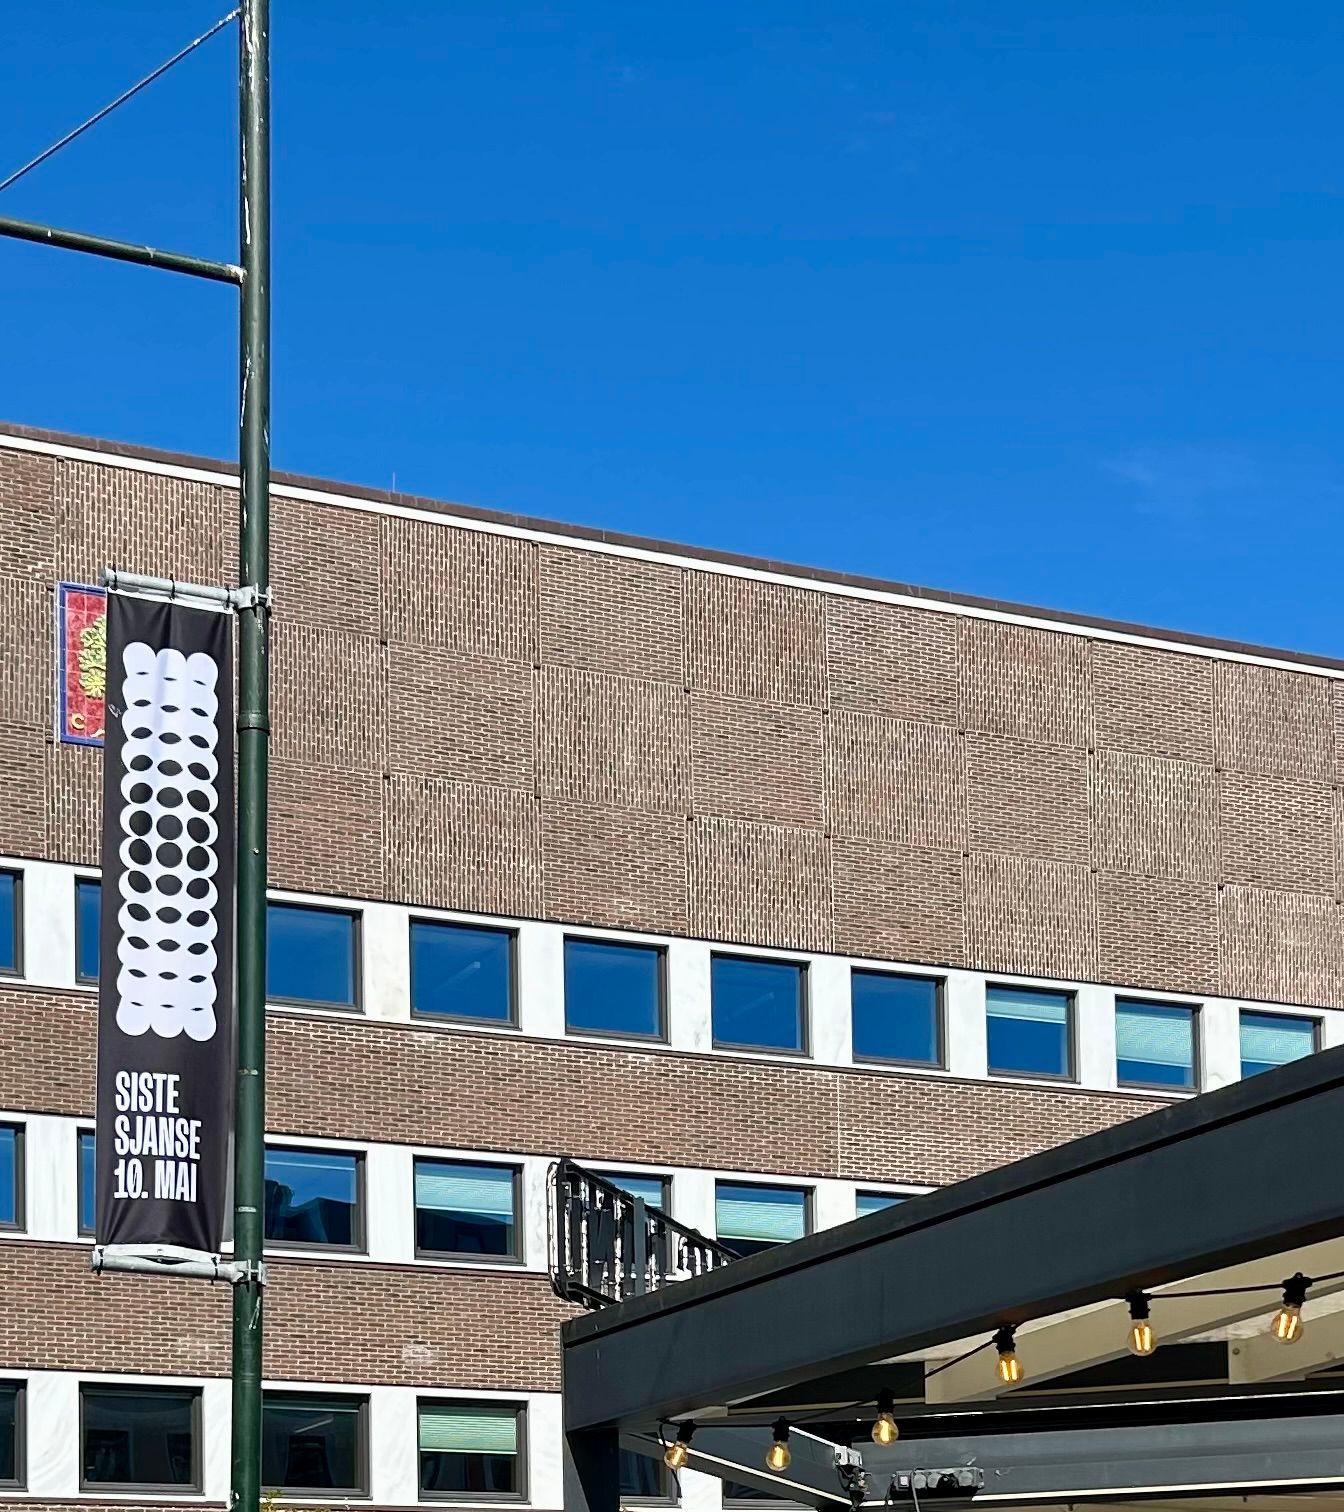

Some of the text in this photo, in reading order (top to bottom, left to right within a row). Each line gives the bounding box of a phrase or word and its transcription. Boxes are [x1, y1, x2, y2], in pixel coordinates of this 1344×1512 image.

[115, 1071, 180, 1114] SISTE
[114, 1115, 202, 1160] SJANSE
[114, 1158, 197, 1203] 10. MAI
